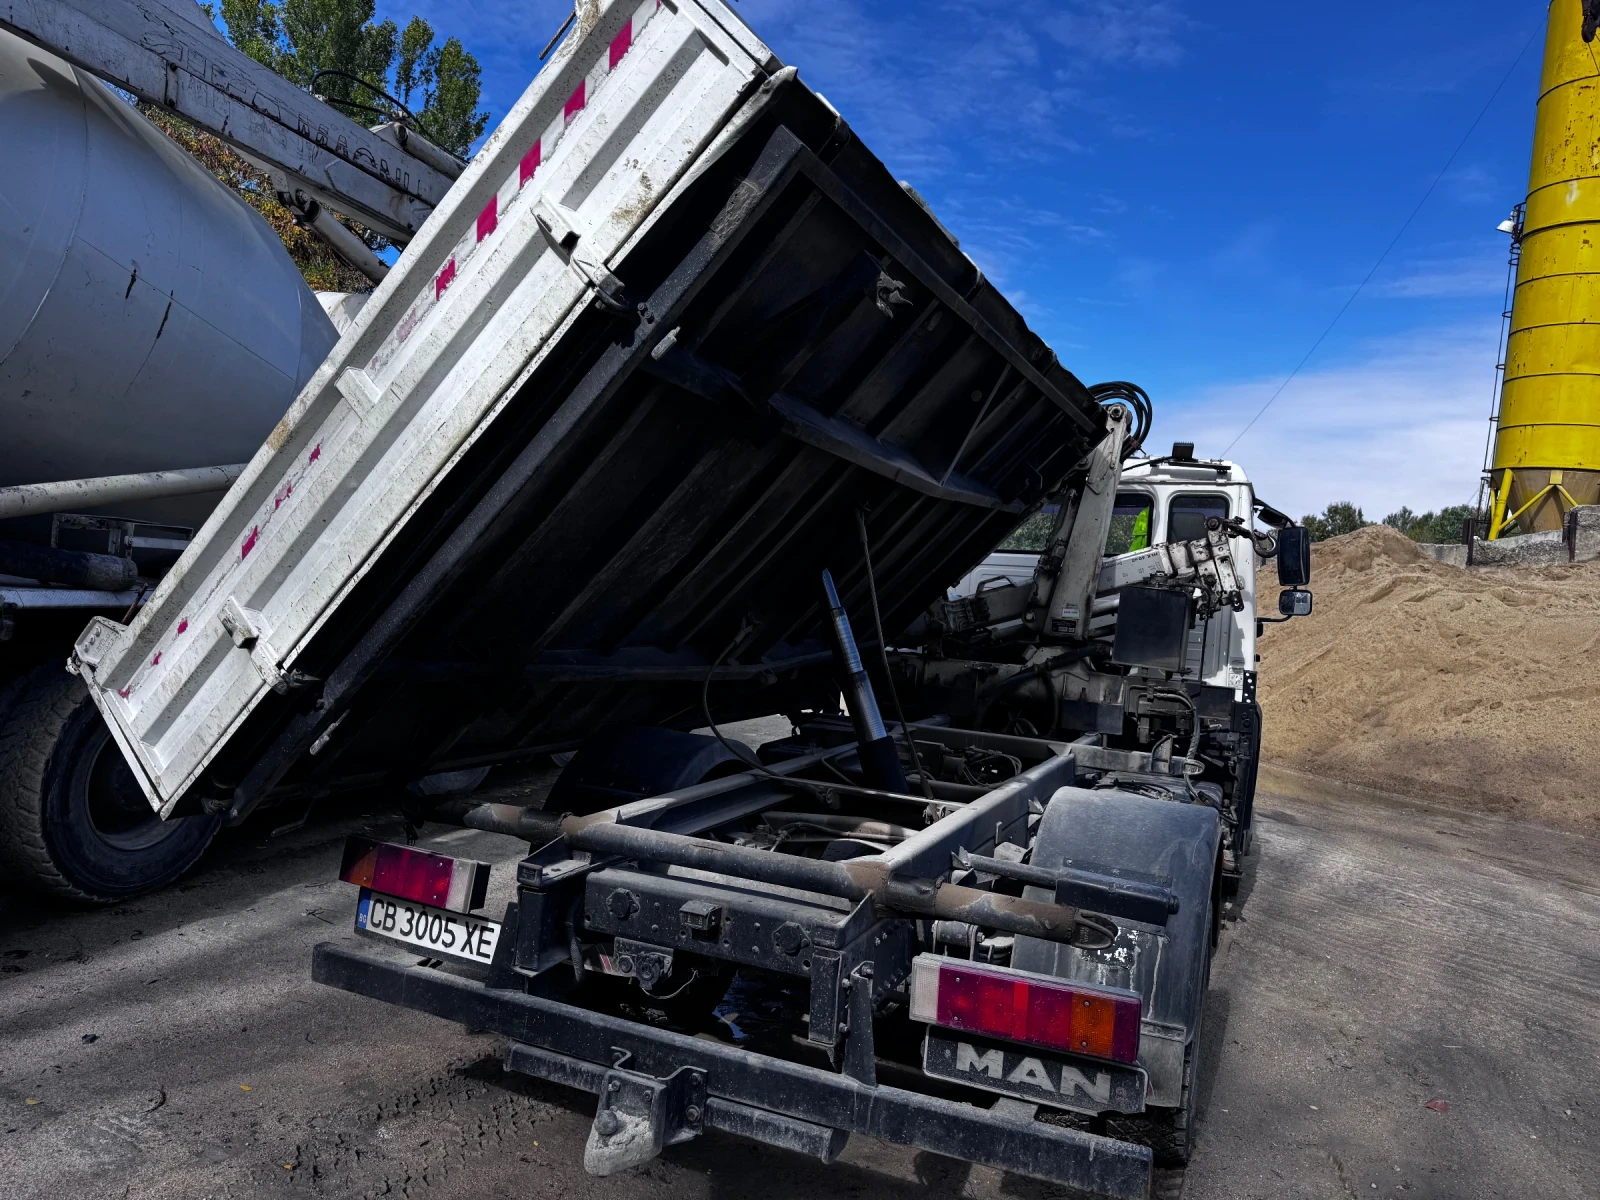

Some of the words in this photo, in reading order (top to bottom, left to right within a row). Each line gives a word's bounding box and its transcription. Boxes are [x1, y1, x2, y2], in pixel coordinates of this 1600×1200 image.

[370, 898, 397, 932] CB
[400, 907, 456, 948] 3005
[460, 921, 495, 959] XE
[956, 1042, 1111, 1103] MAN
